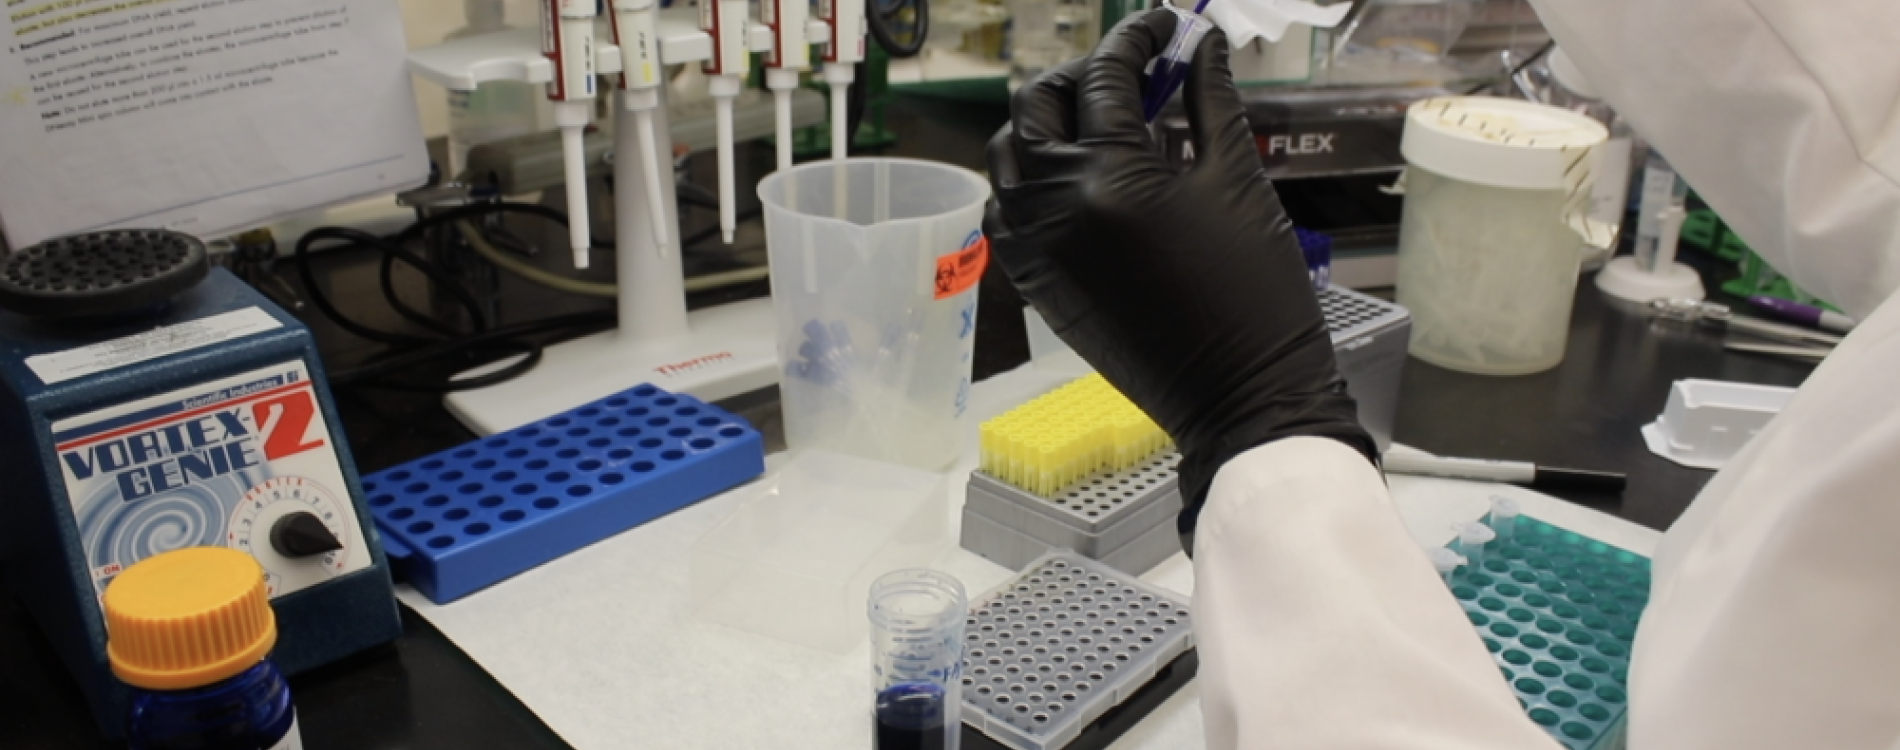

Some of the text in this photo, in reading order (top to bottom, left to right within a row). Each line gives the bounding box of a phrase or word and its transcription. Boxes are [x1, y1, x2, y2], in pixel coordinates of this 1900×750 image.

[1268, 133, 1334, 156] FLEX
[652, 351, 733, 376] Thermo
[182, 379, 278, 411] Scientific Industries
[252, 390, 325, 461] 2
[116, 437, 260, 502] GENIE
